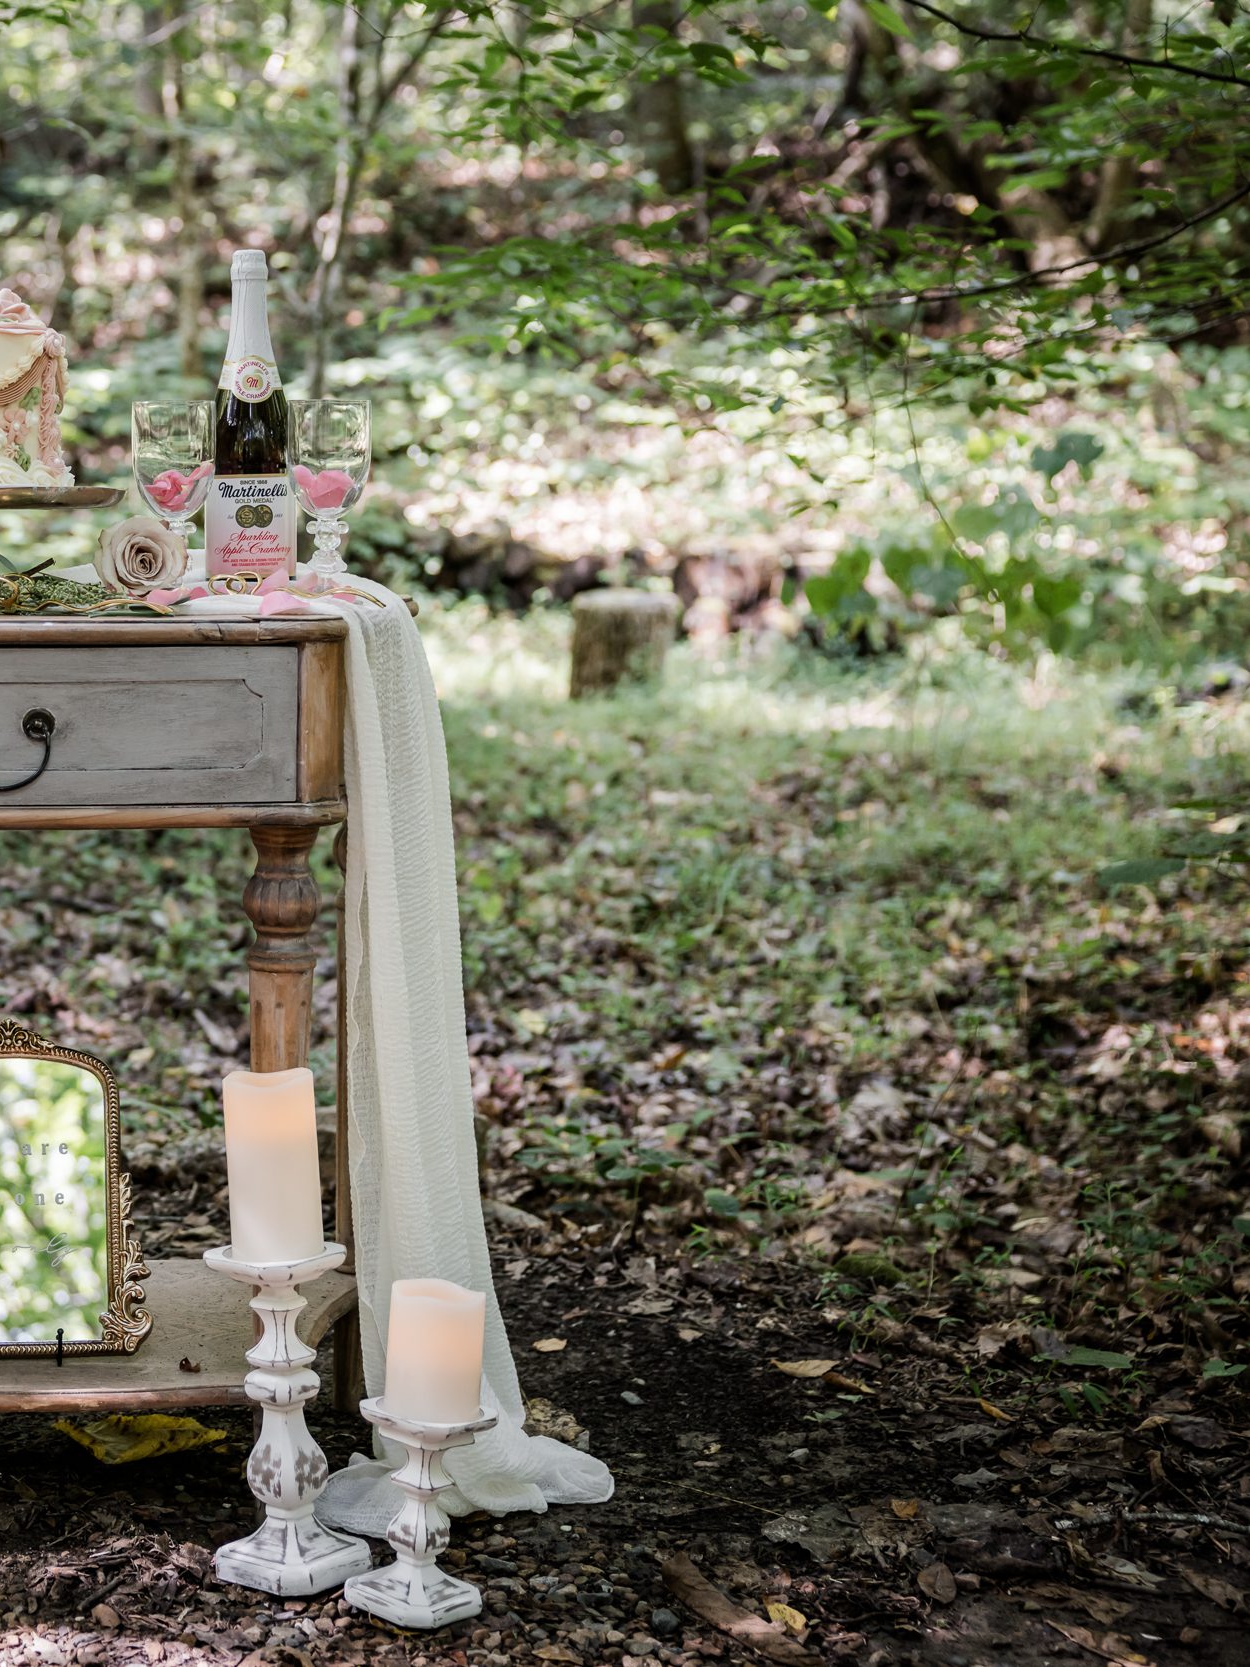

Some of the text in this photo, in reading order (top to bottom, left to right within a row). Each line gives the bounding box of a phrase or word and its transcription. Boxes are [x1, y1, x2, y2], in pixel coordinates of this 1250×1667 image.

[230, 529, 278, 545] Sparkling
[215, 542, 291, 558] Apple-Cranberry
[21, 1142, 69, 1156] are
[14, 1192, 65, 1206] one
[11, 1232, 80, 1268] only
